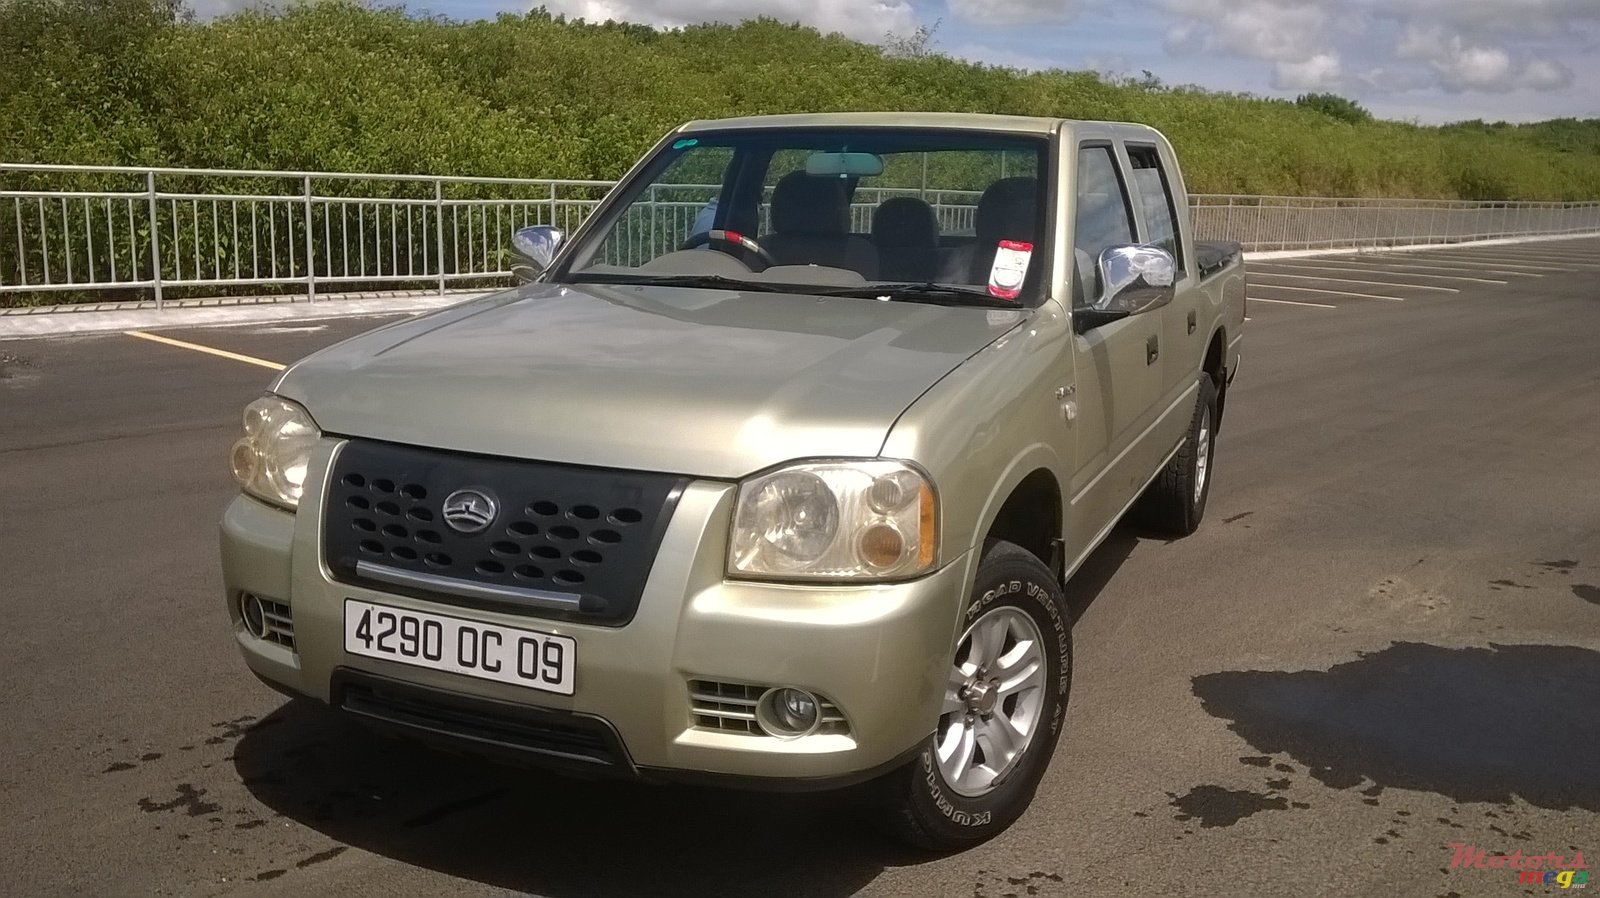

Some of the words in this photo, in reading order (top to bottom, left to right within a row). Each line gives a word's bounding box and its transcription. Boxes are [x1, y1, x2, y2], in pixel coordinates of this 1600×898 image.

[355, 608, 442, 661] 4290
[517, 636, 564, 685] 09
[966, 580, 1022, 620] ROAD
[1026, 582, 1068, 696] VENTURE
